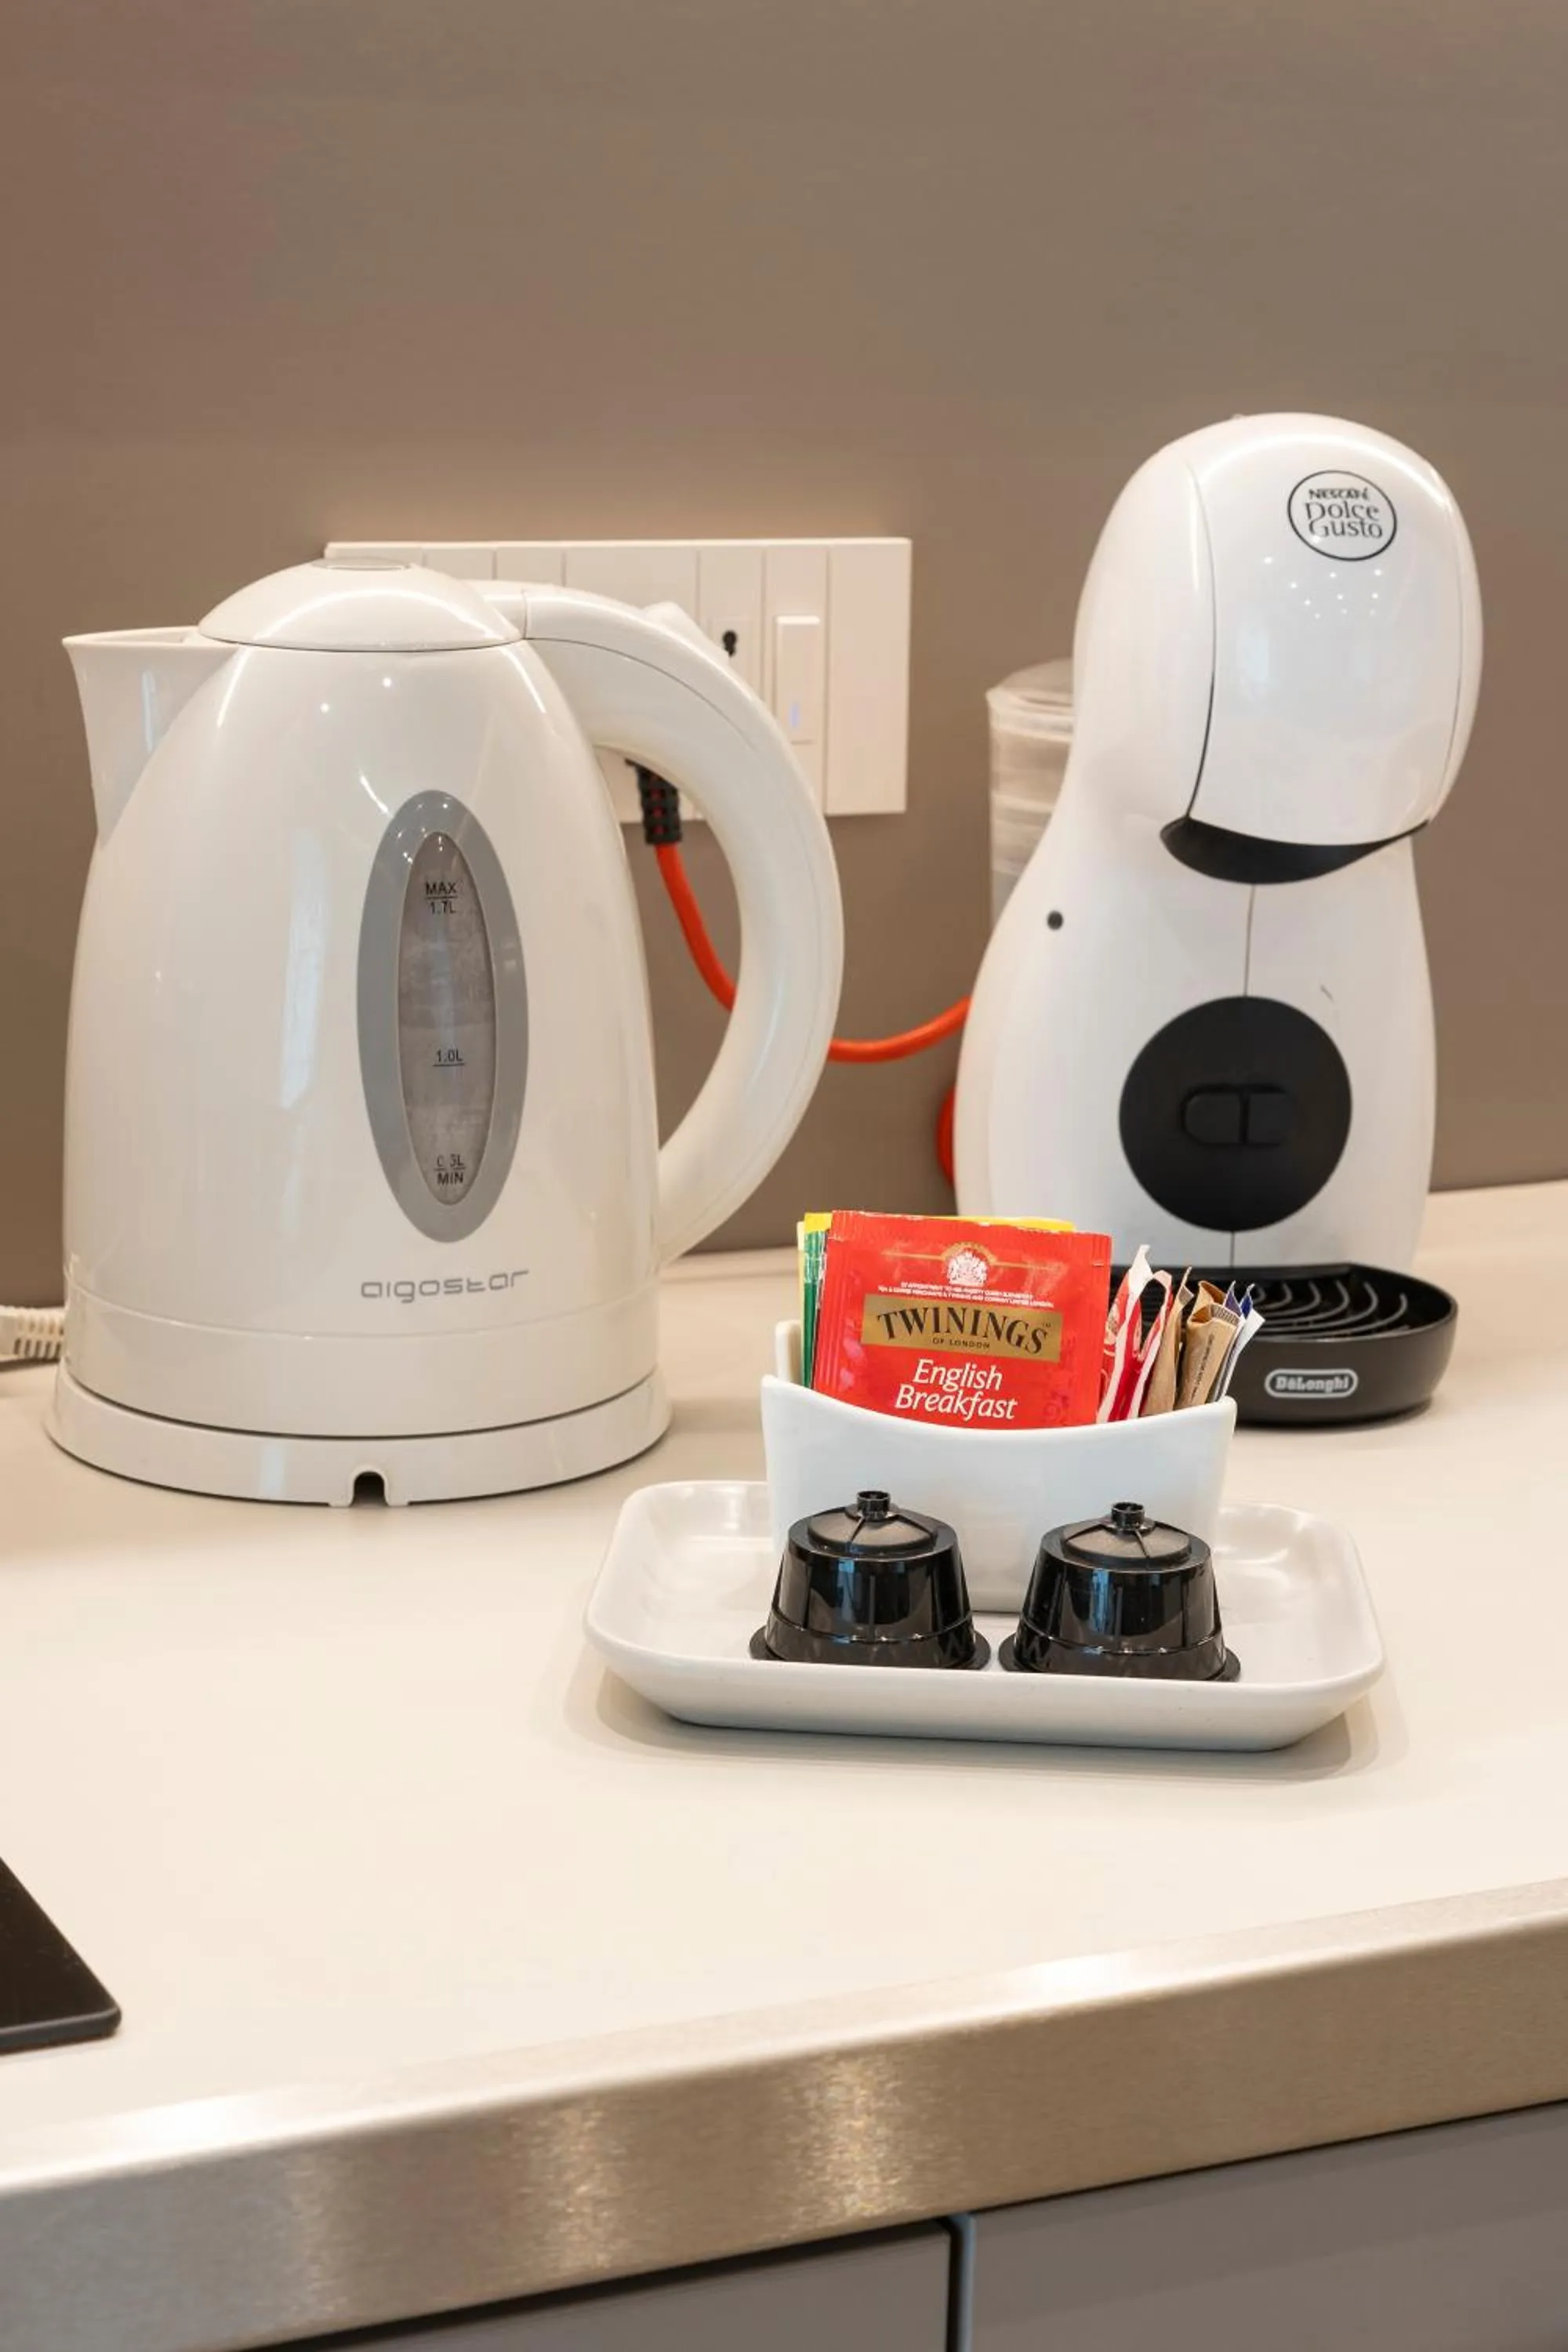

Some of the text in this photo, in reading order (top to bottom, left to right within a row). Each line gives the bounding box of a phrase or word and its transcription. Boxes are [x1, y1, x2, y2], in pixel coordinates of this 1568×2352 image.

[1305, 500, 1380, 522] Dolce
[1308, 518, 1383, 539] Gusto
[426, 881, 457, 895] MAX
[436, 1047, 464, 1062] 1.0L
[437, 1171, 464, 1186] MIN
[361, 1269, 530, 1304] aigostar
[877, 1306, 1049, 1355] TWININGS
[932, 1337, 991, 1349] OF LONDON
[912, 1358, 1004, 1392] English
[894, 1383, 1018, 1422] Breakfast
